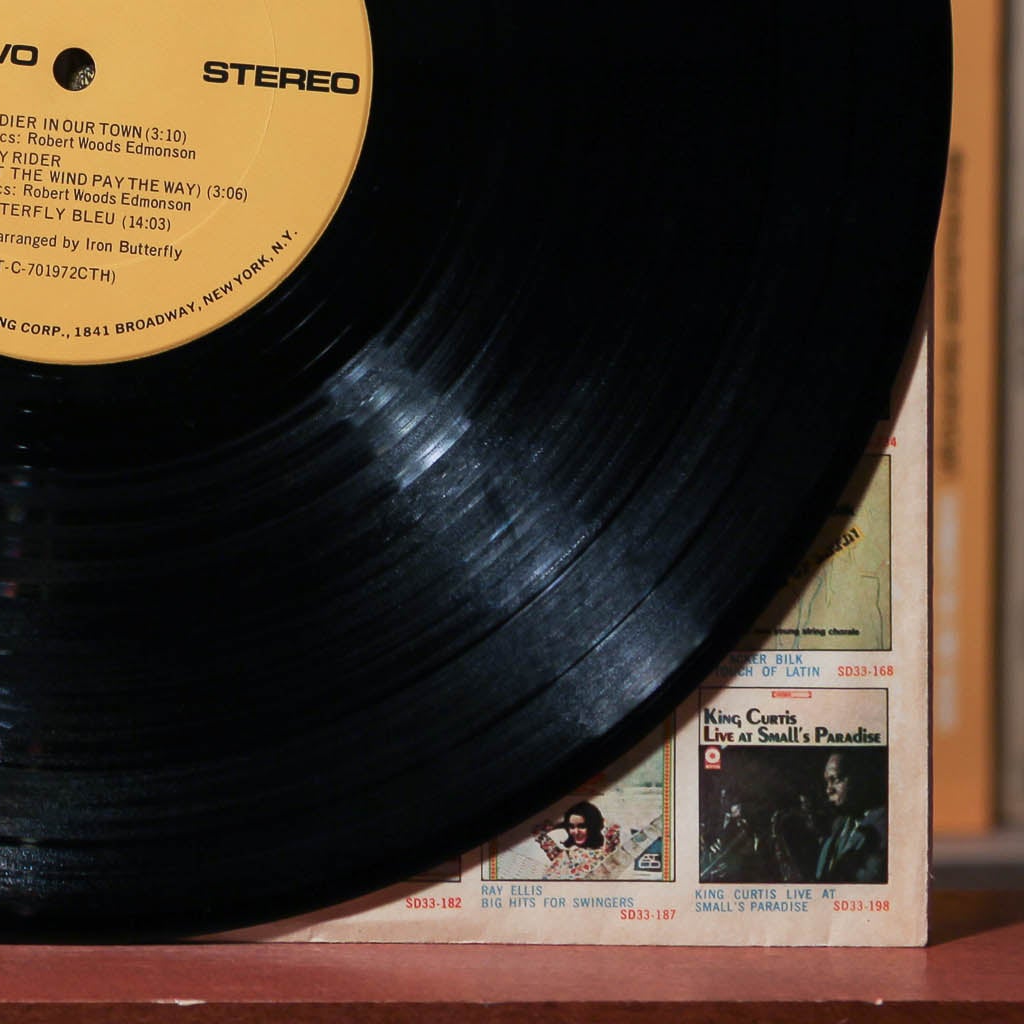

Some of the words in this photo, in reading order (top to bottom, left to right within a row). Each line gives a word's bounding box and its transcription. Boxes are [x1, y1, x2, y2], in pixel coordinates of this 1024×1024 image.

[202, 60, 360, 96] STEREO
[43, 117, 59, 131] IN
[62, 119, 95, 135] OUR
[98, 123, 142, 139] TOWN
[145, 127, 188, 145] (3:10)
[27, 132, 74, 149] Robert
[78, 136, 121, 153] Woods
[125, 141, 196, 160] Edmonson
[12, 151, 62, 167] RIDER
[11, 166, 43, 182] THE
[49, 170, 88, 186] WIND
[92, 174, 125, 190] PAY
[127, 176, 159, 193] THE
[163, 181, 202, 198] WAY)
[206, 184, 248, 203] (3:06)
[23, 184, 70, 201] Robert
[73, 188, 117, 205] Woods
[121, 193, 192, 212] Edmonson
[72, 209, 115, 225] BLEU
[121, 214, 171, 232] (14:03)
[62, 236, 80, 252] by
[86, 237, 113, 252] Iron
[119, 240, 183, 261] Butterfly
[20, 322, 70, 339] CORP.,
[74, 324, 110, 338] 1841
[115, 301, 202, 335] BROADWAY,
[202, 280, 234, 306] NEW
[233, 254, 274, 286] YORK,
[271, 229, 298, 255] N.Y.
[775, 654, 803, 665] BILK
[762, 666, 777, 677] OF
[786, 666, 820, 677] LATIN
[837, 665, 894, 677] SD33-168
[481, 885, 503, 896] RAY
[510, 885, 543, 896] ELLIS
[694, 888, 722, 901] KING
[733, 889, 777, 901] CURTIS
[786, 889, 812, 901] LIVE
[821, 889, 837, 900] AT
[405, 897, 462, 909] SD33-182
[481, 897, 502, 908] BIG
[509, 897, 536, 908] HITS
[543, 897, 566, 908] FOR
[572, 897, 634, 908] SWINGERS
[694, 900, 746, 913] SMALL'S
[749, 901, 810, 913] PARADISE
[832, 900, 891, 912] SD33-198
[619, 909, 676, 921] SD33-187
